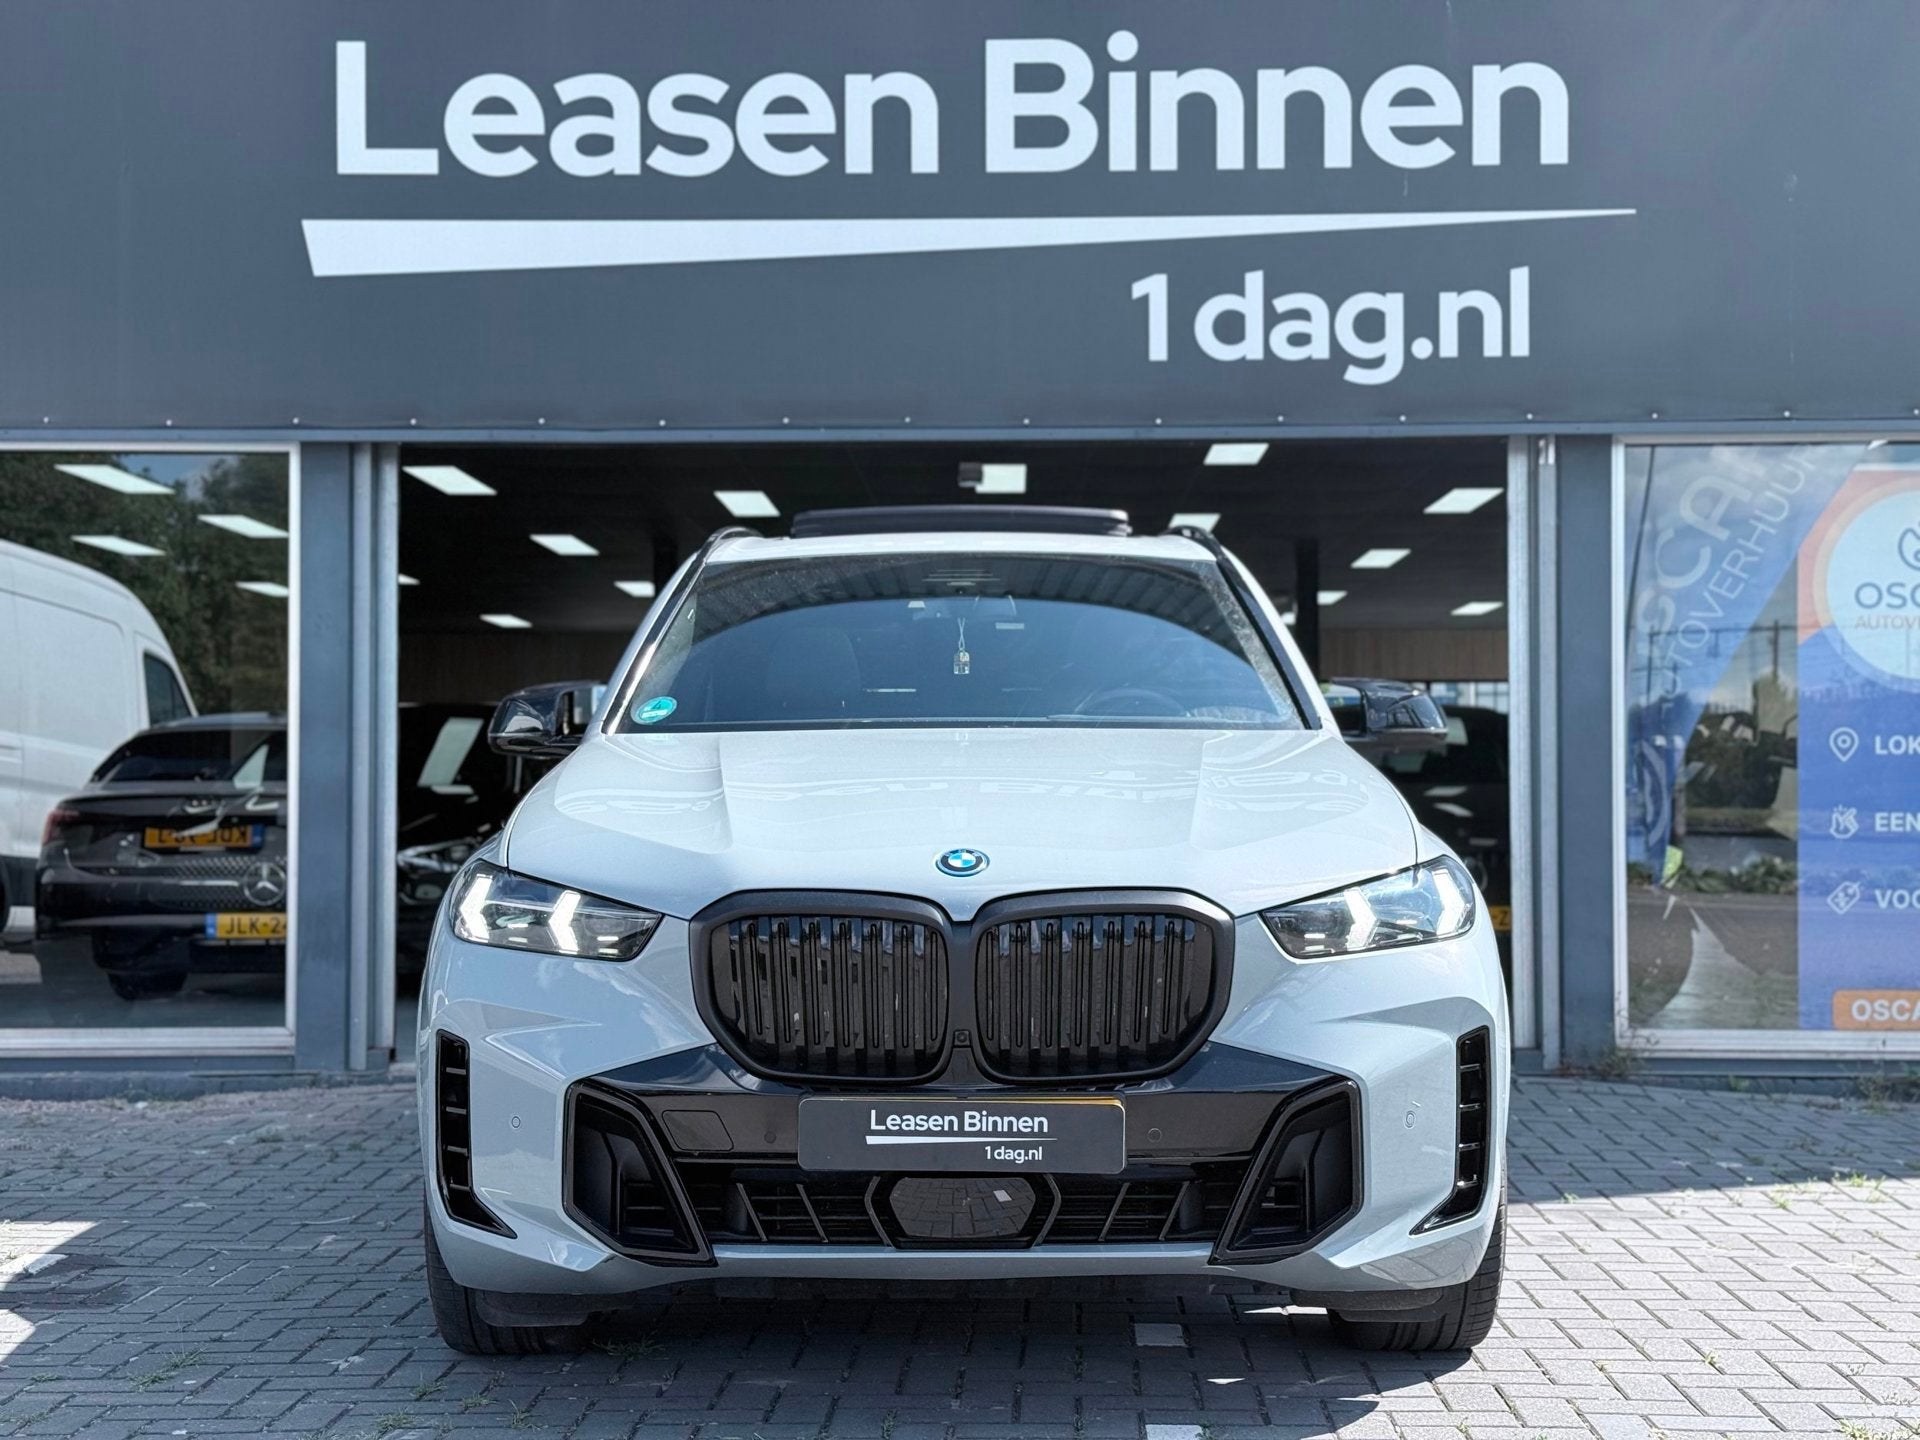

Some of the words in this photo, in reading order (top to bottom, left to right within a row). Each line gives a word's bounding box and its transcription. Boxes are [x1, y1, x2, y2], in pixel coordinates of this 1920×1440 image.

[335, 40, 939, 178] Leasen
[985, 30, 1569, 174] Binnen
[1855, 614, 1920, 631] AUTOV
[1874, 812, 1920, 833] EEN
[225, 916, 286, 934] JLK-2
[869, 1108, 960, 1133] Leasen
[962, 1109, 1050, 1134] Binnen
